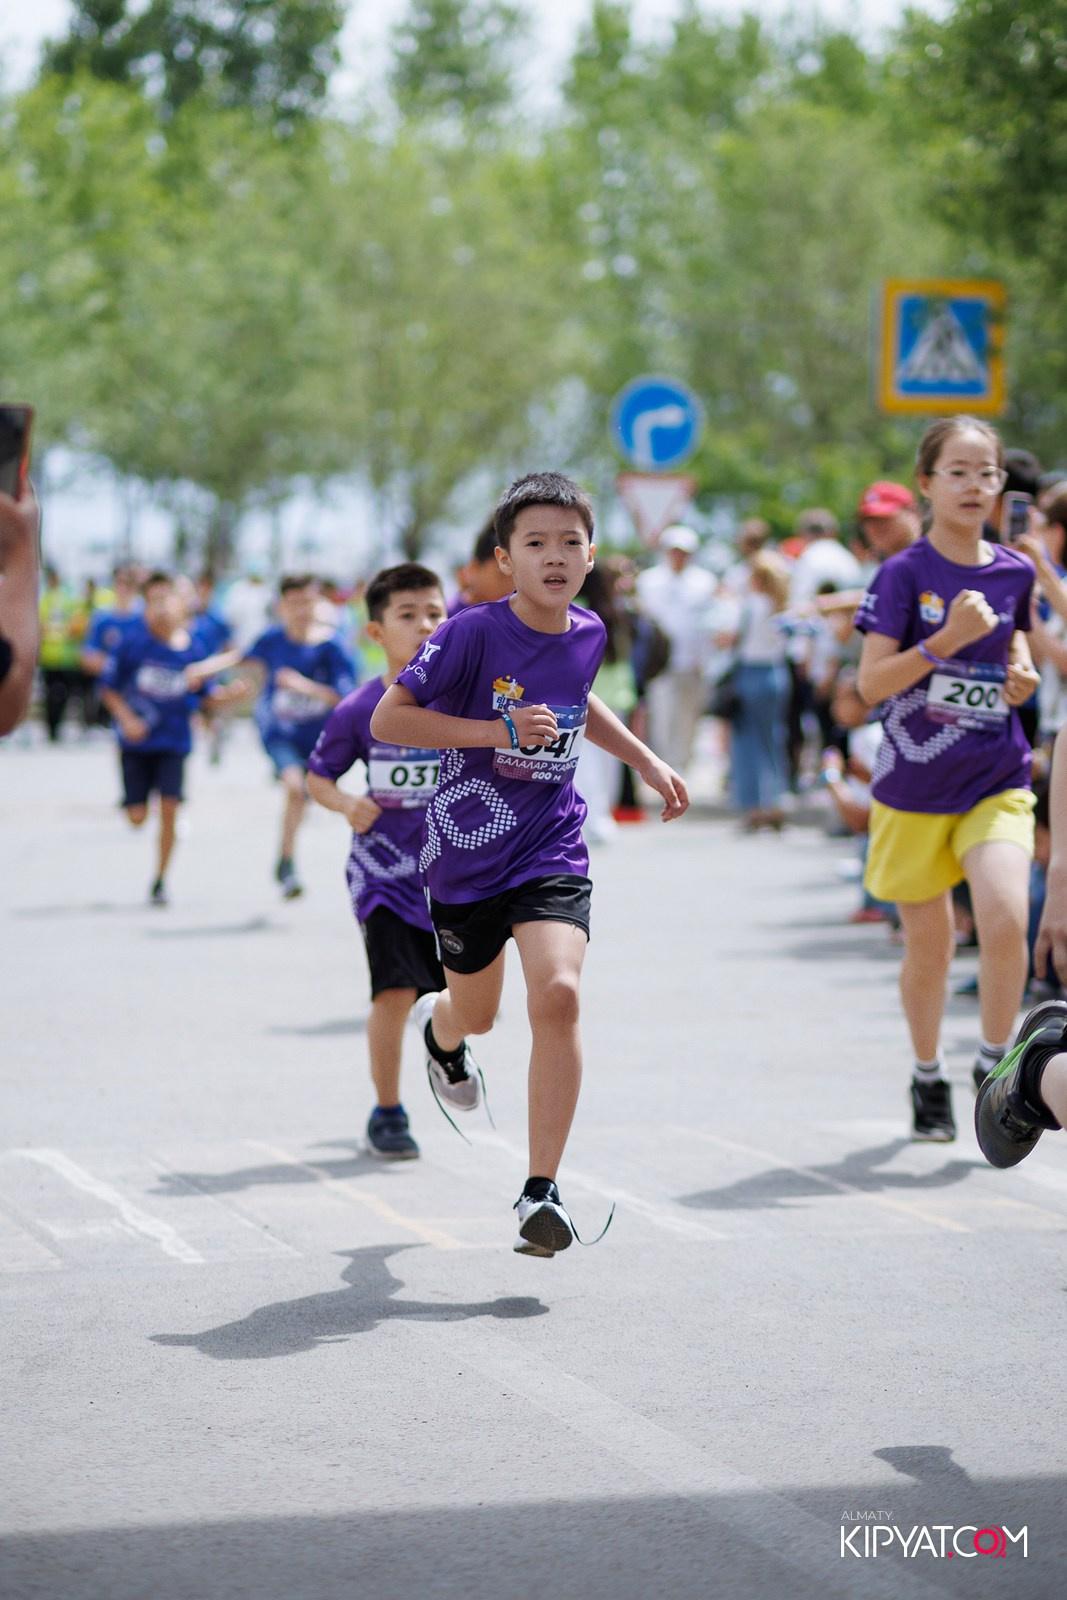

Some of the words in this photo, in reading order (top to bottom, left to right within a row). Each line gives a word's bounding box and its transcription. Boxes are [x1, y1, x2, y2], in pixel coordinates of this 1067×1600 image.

[943, 682, 999, 709] 200
[496, 755, 548, 771] БАЛАЛАР
[390, 765, 440, 787] 031
[531, 771, 552, 780] 600
